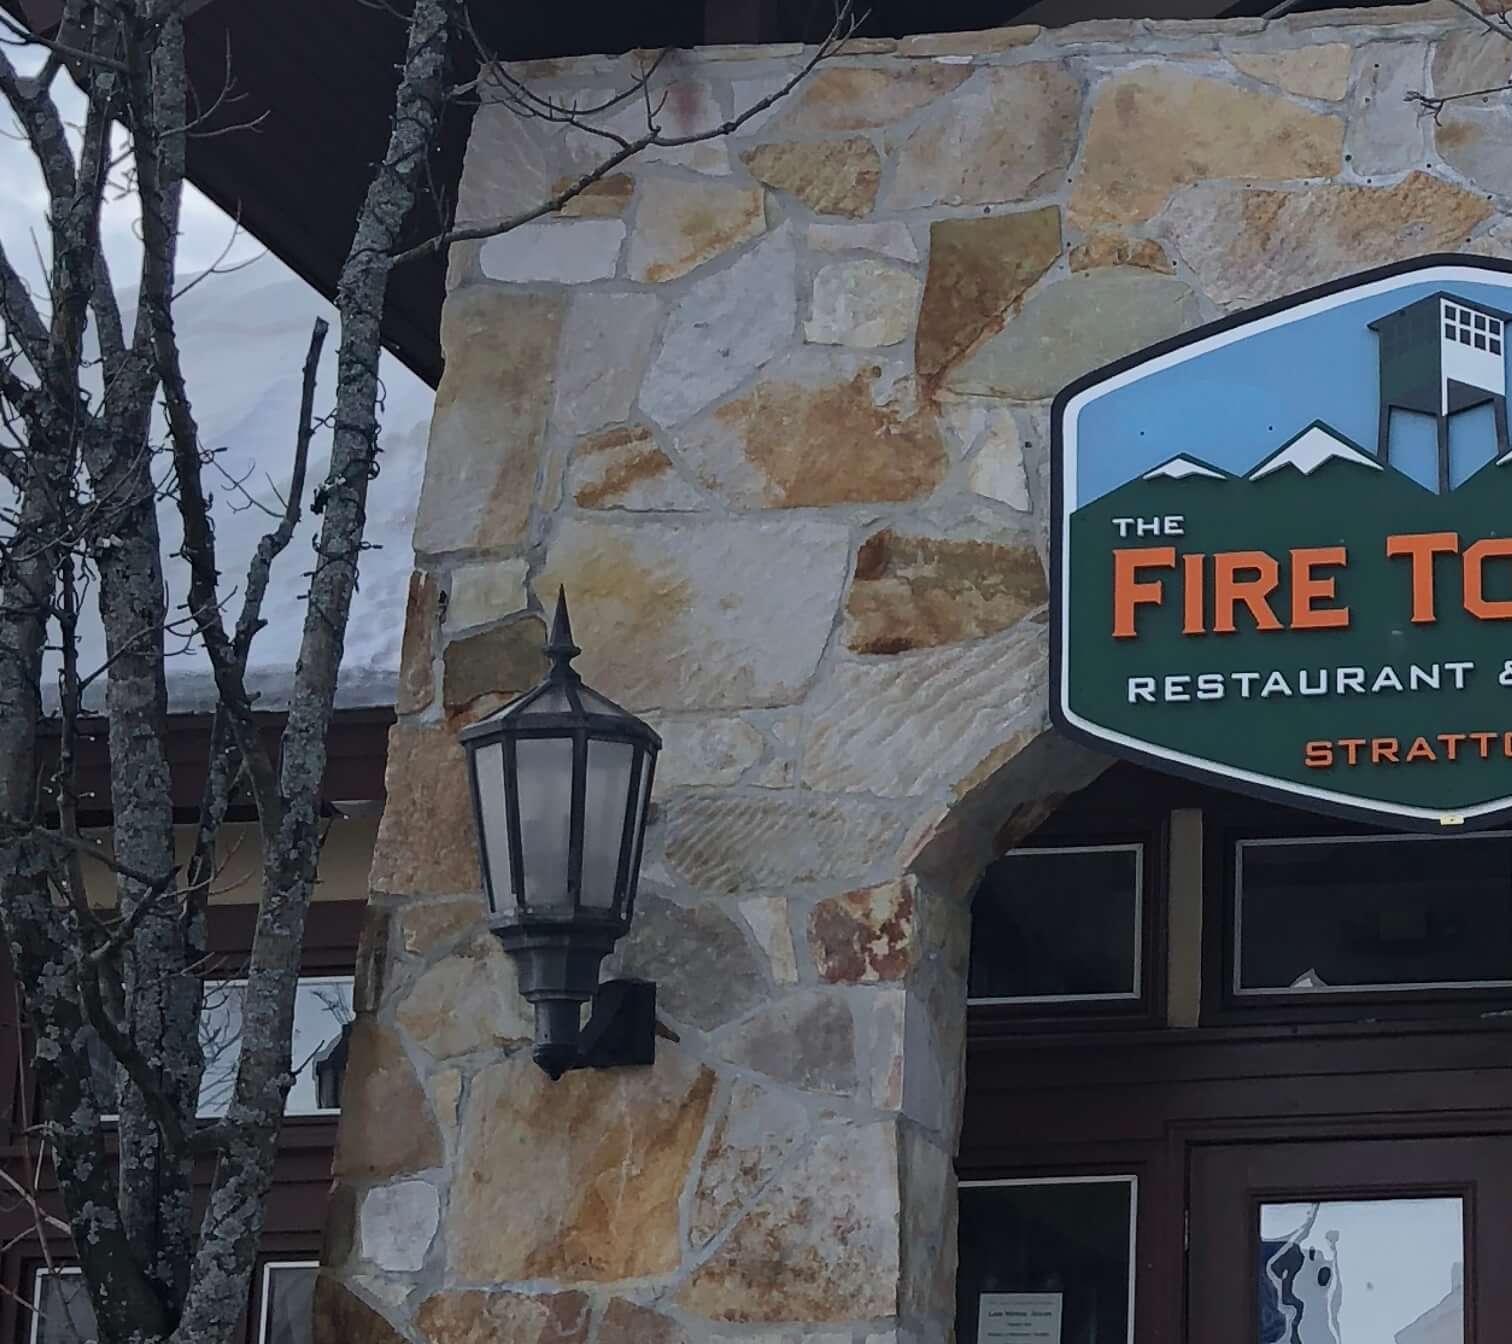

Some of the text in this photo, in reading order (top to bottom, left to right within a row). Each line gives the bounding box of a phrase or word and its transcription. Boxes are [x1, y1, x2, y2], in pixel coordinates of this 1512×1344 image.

[1111, 515, 1185, 538] THE
[1111, 546, 1350, 638] FIRE
[1127, 661, 1475, 704] RESTAURANT
